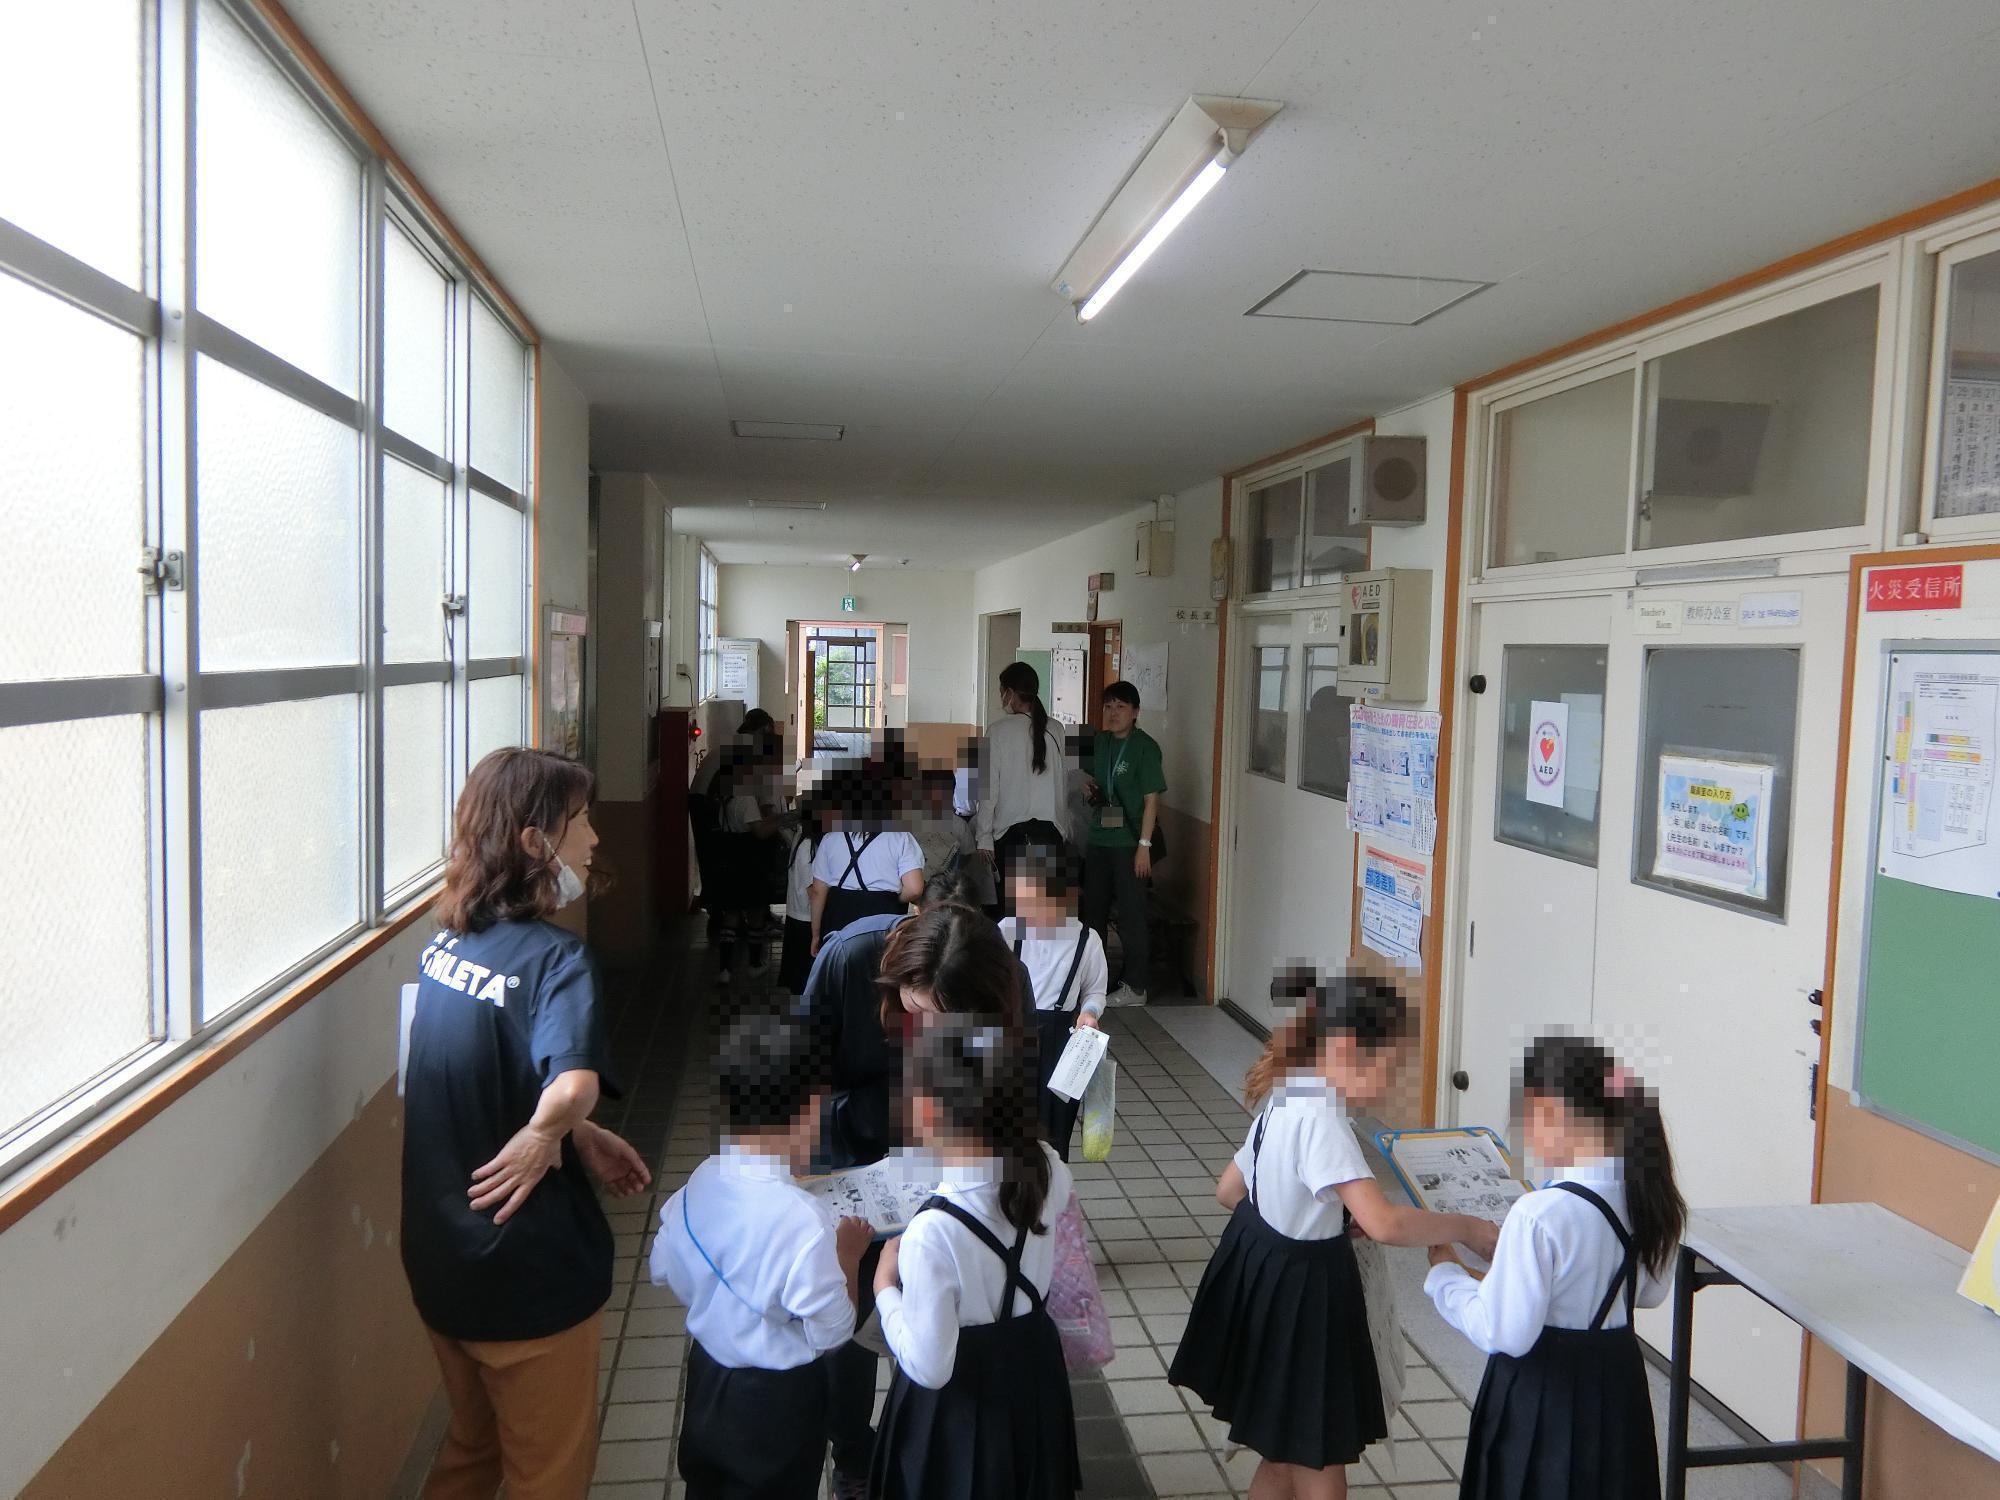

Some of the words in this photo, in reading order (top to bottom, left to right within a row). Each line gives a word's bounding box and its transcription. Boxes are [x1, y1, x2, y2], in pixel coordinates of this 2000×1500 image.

[1362, 584, 1381, 597] AED
[1869, 576, 1962, 600] 火災受信所
[1176, 609, 1214, 621] 校長室
[1539, 765, 1554, 775] AED
